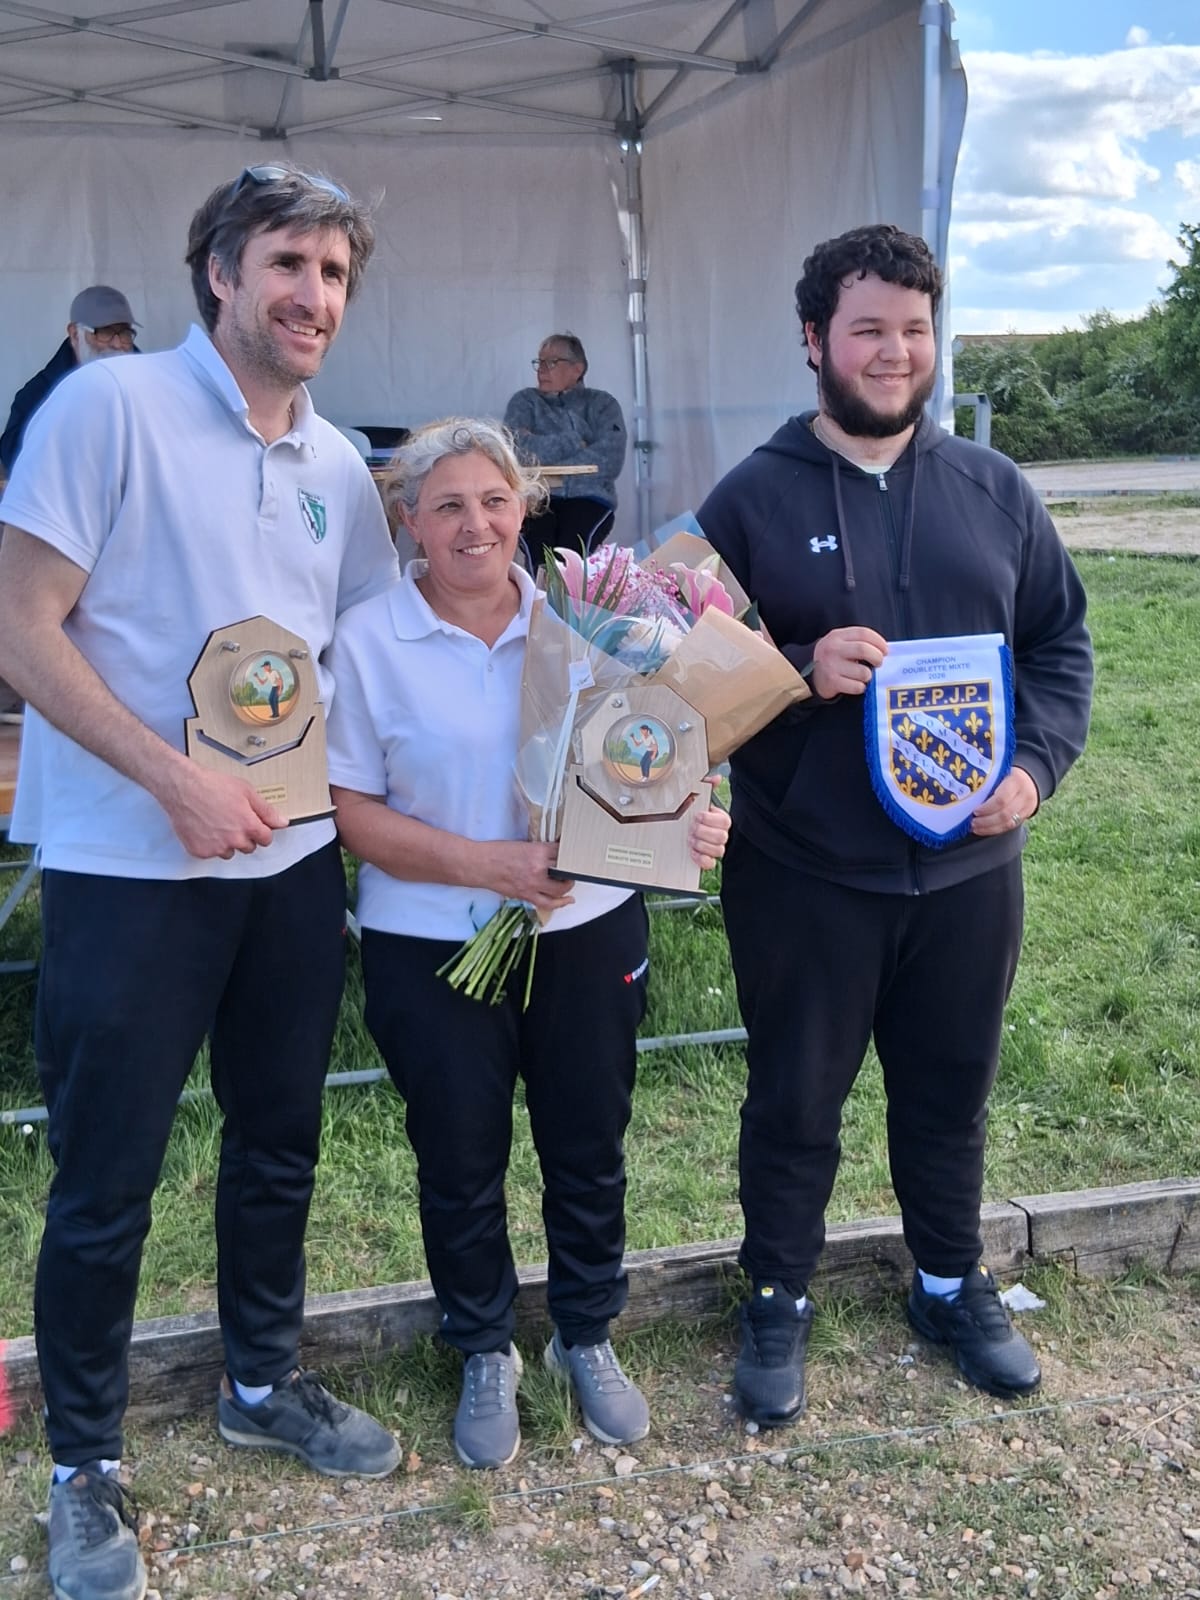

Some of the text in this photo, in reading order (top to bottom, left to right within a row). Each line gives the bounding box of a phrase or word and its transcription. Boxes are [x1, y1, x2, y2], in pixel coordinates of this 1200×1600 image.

[915, 656, 956, 665] CHAMPION
[902, 662, 971, 674] DOUBLETTE MIXTE
[897, 685, 982, 707] F.F.P.J.P.
